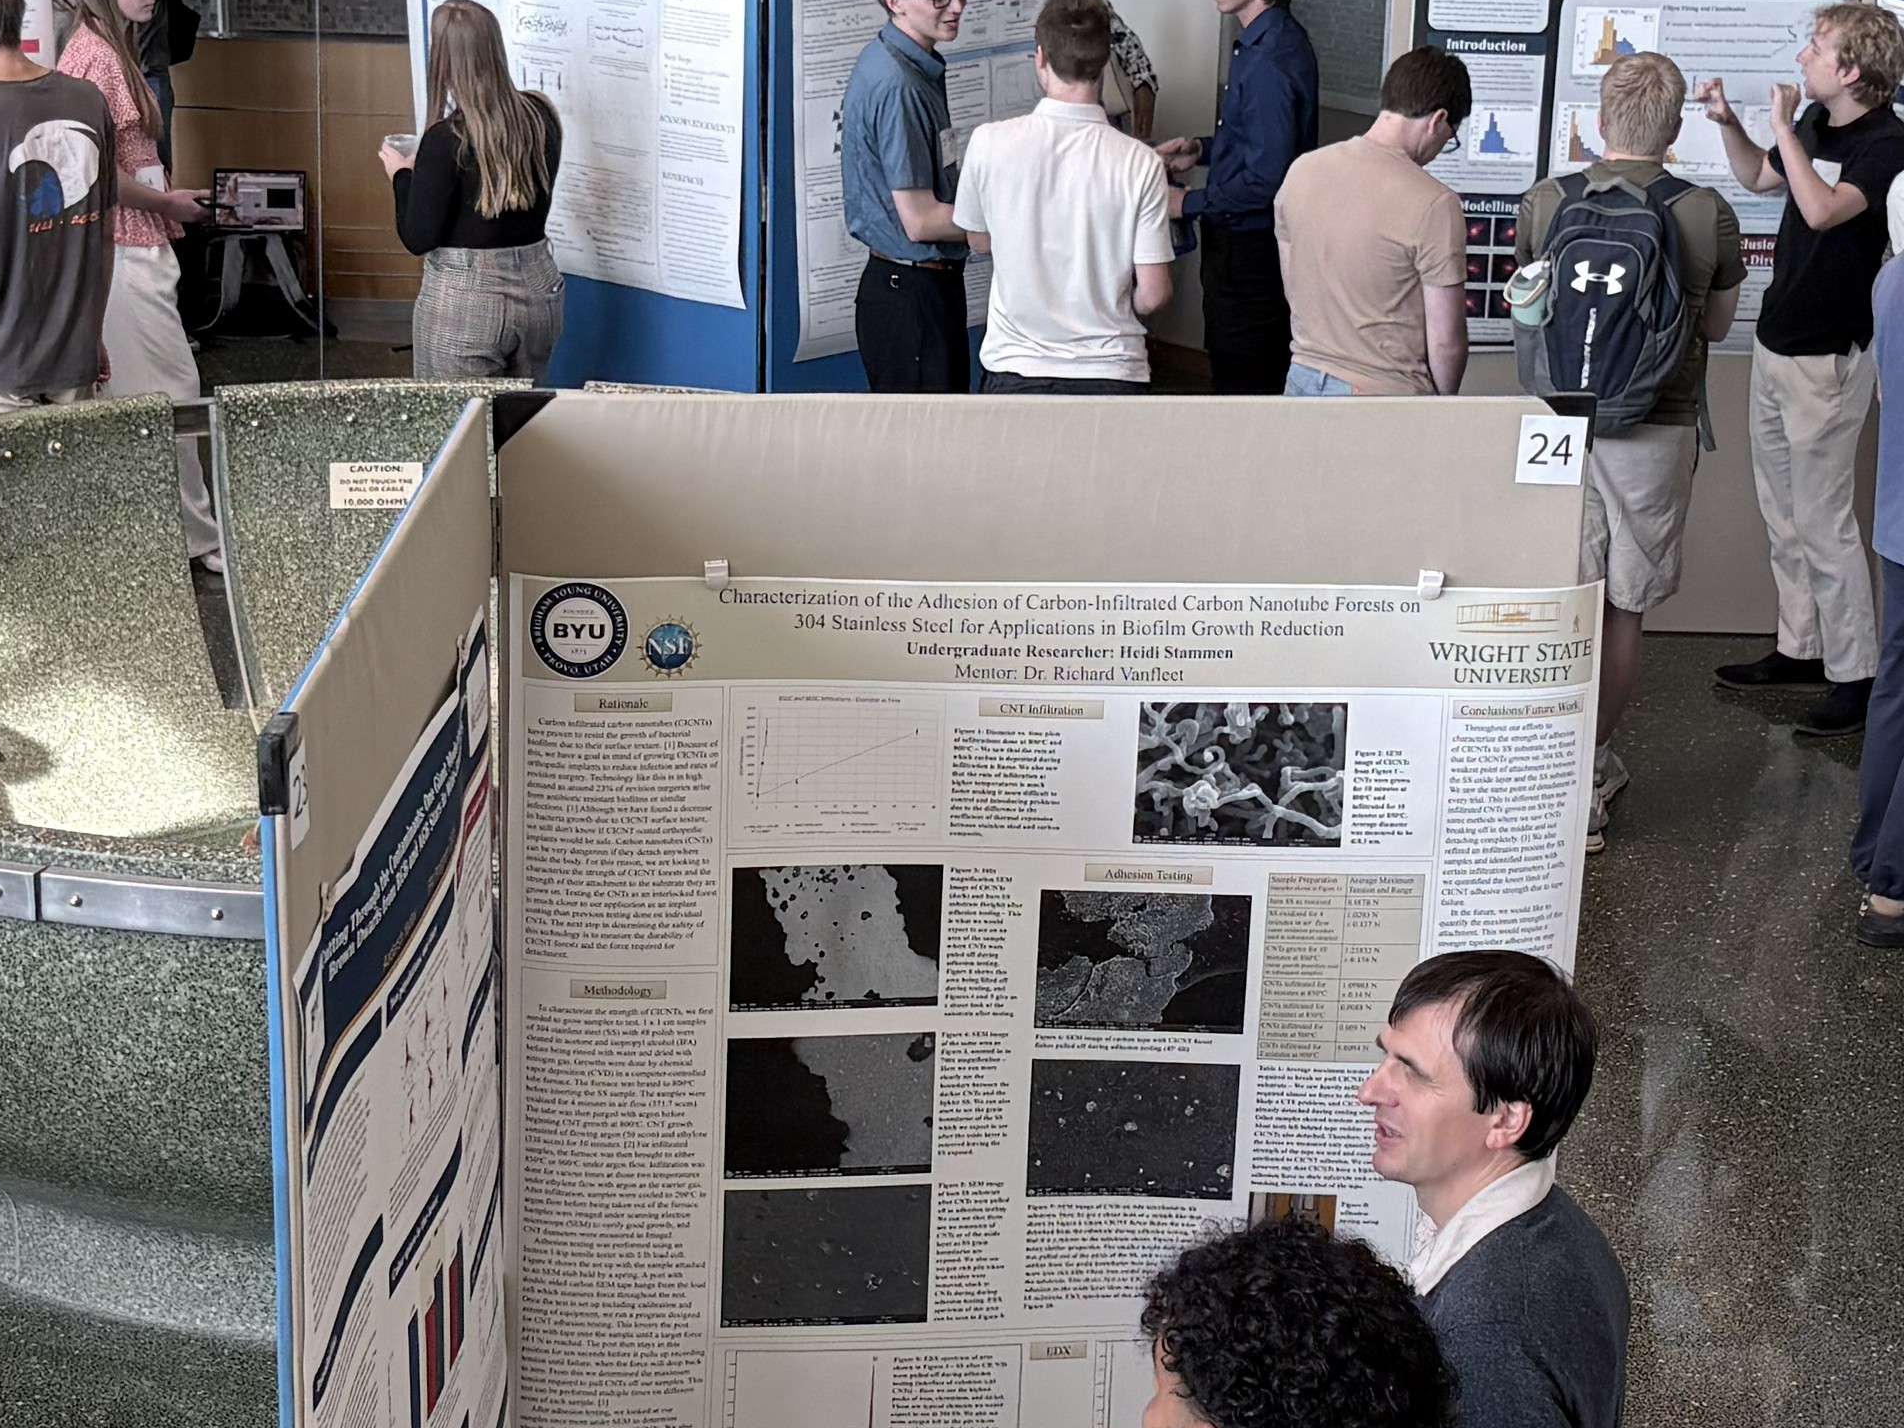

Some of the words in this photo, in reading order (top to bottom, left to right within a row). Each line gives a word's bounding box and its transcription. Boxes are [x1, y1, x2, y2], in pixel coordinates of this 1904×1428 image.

[1446, 38, 1527, 53] Introduction
[1527, 432, 1573, 466] 24
[719, 589, 859, 606] Characterization
[864, 591, 884, 607] of
[888, 593, 913, 609] the
[918, 593, 998, 610] Adhesion
[1003, 594, 1023, 610] of
[1026, 594, 1177, 612] Carbon-Infiltrated
[1182, 595, 1243, 612] Carbon
[1249, 596, 1330, 612] Nanotube
[1334, 596, 1394, 613] Forests
[1400, 600, 1420, 613] on
[553, 623, 606, 639] BYU
[794, 614, 825, 630] 304
[832, 615, 906, 633] Stainless
[912, 617, 953, 633] Steel
[960, 618, 985, 634] for
[988, 619, 1094, 638] Applications
[1101, 620, 1116, 636] in
[1122, 620, 1185, 636] Biofilm
[1191, 621, 1254, 637] Growth
[1261, 621, 1344, 637] Reduction
[648, 637, 693, 656] NSF
[1120, 646, 1159, 660] Heidi
[1164, 646, 1233, 660] Stammen
[1429, 641, 1529, 664] WRIGHT
[1536, 637, 1593, 662] STATE
[1454, 664, 1572, 685] UNIVERSITY
[599, 698, 648, 710] Rationale
[584, 985, 653, 998] Methodology
